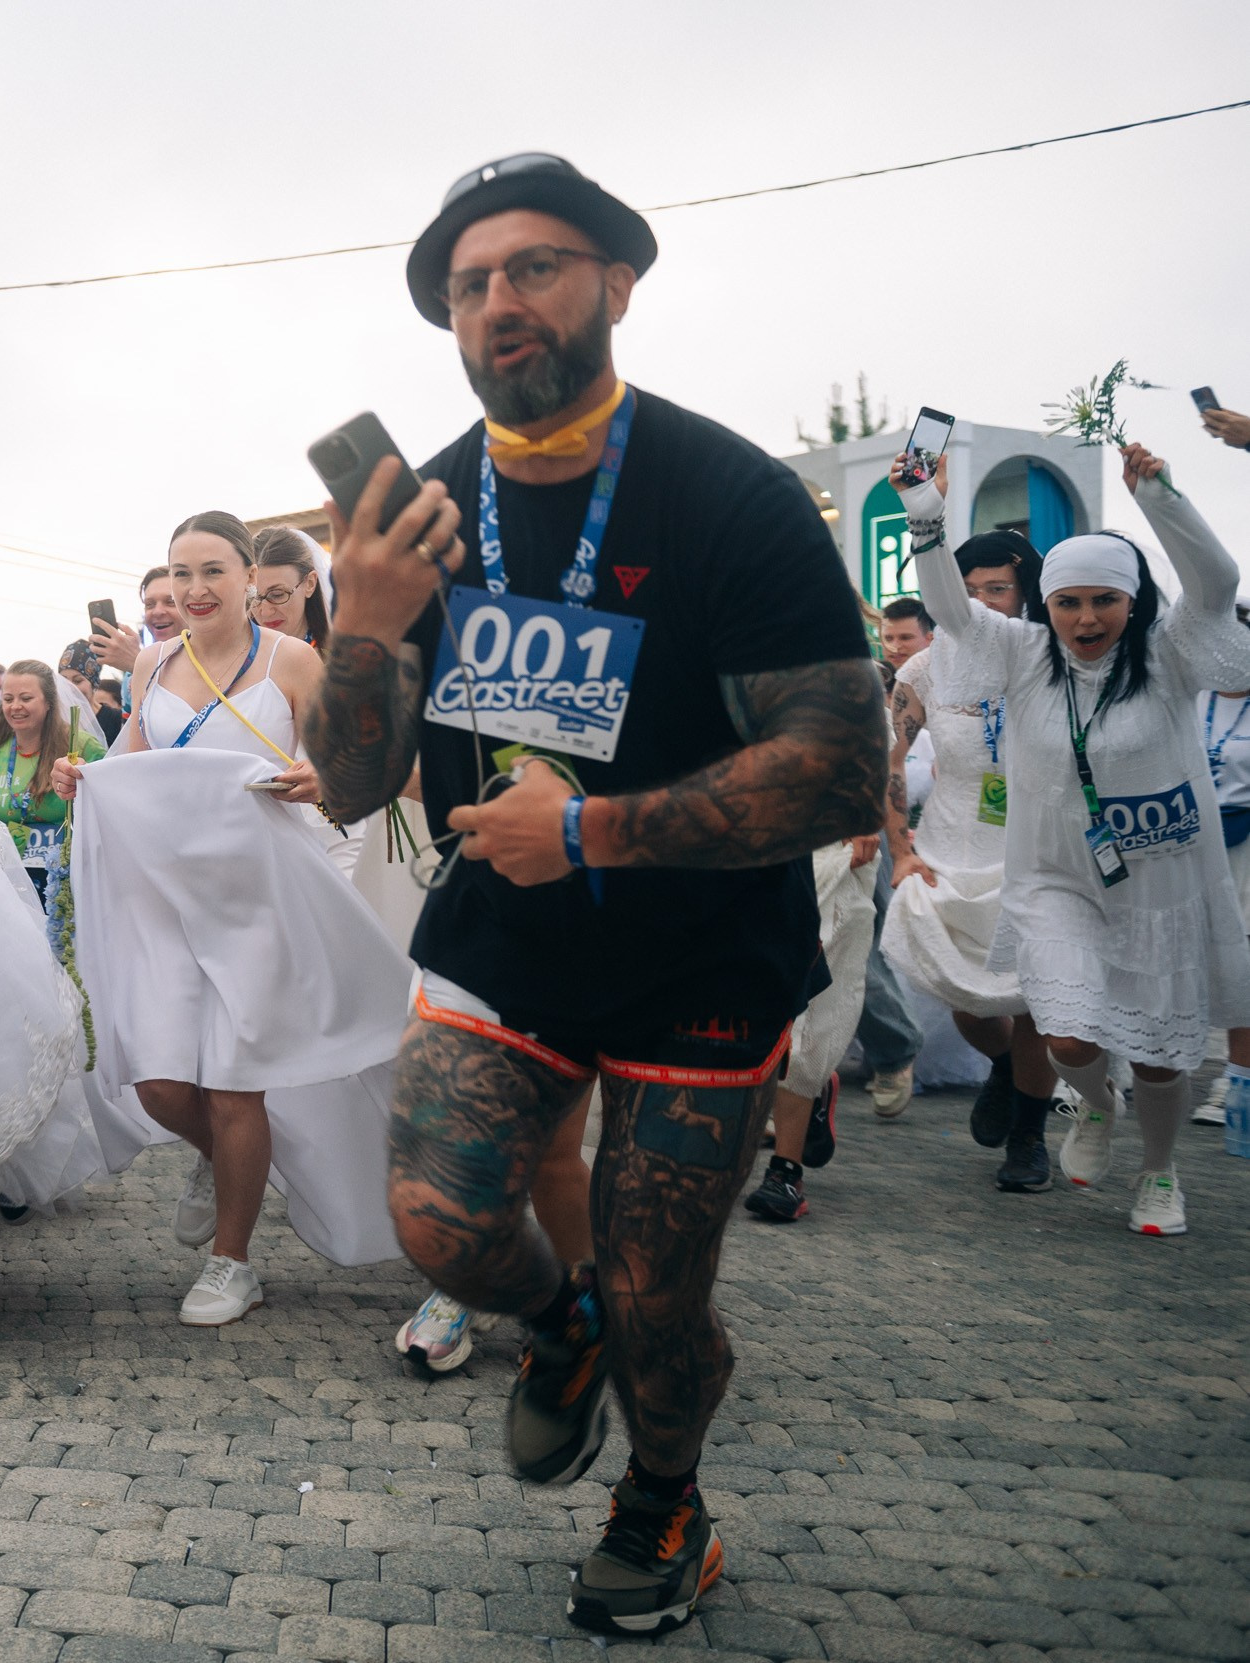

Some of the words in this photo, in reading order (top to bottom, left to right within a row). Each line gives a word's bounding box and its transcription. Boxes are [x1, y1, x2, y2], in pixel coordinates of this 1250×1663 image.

[461, 605, 613, 680] 001
[433, 664, 627, 713] Gastreet
[1104, 792, 1187, 836] 001
[29, 828, 56, 848] 01
